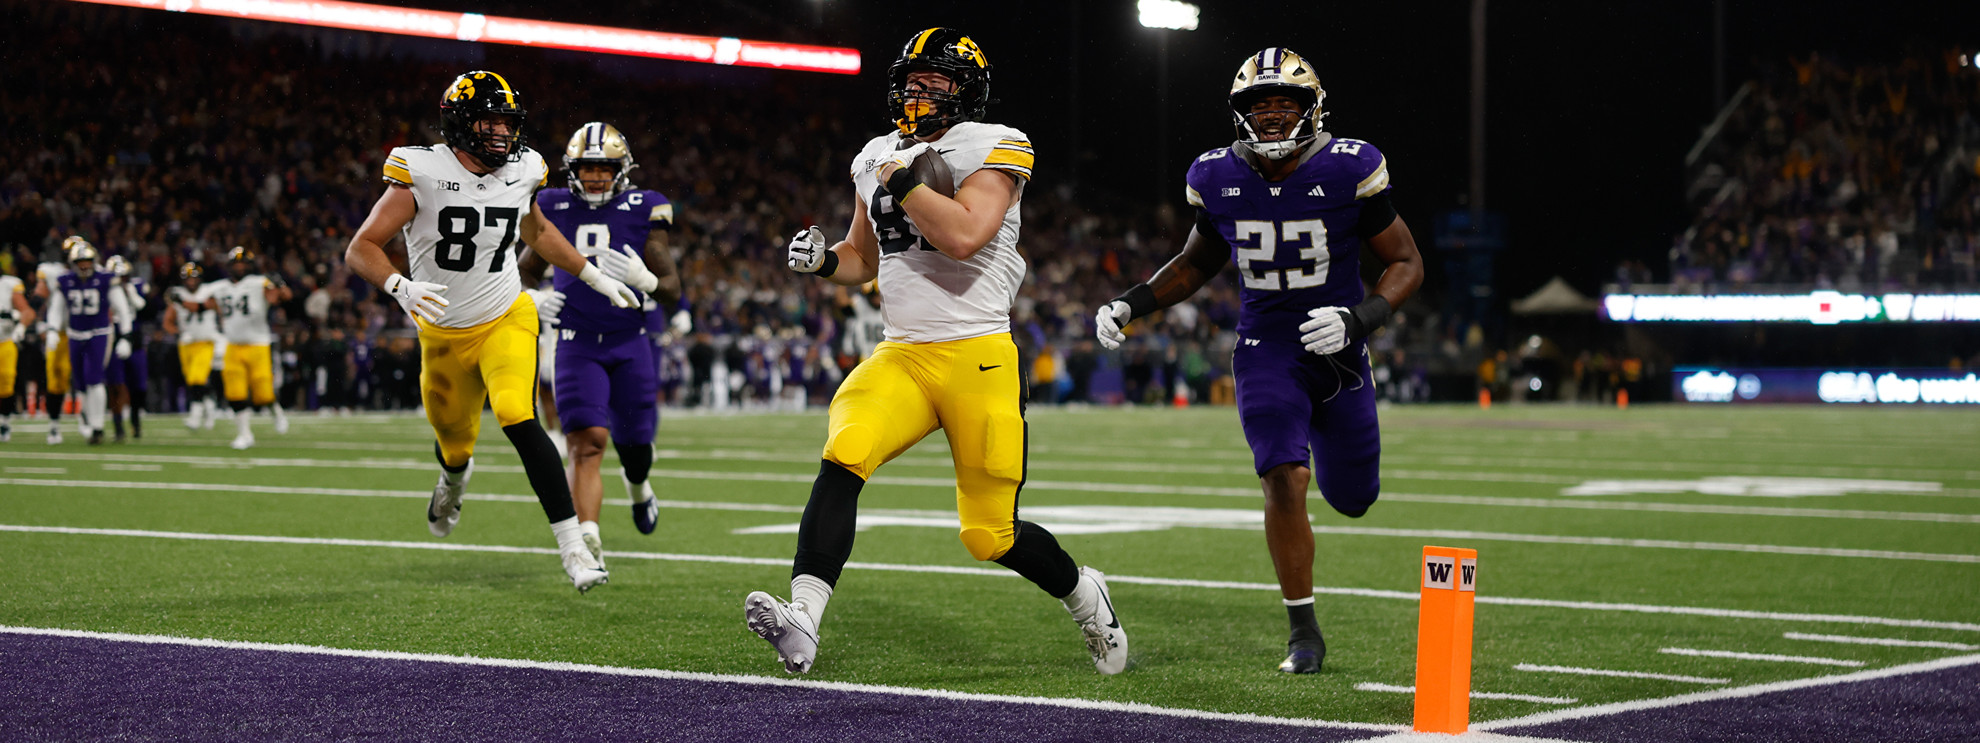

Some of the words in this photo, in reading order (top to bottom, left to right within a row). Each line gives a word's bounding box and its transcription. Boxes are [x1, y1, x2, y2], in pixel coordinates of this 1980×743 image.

[628, 193, 644, 204] C
[1269, 187, 1282, 196] W
[870, 185, 938, 256] 8
[434, 205, 519, 273] 87
[1235, 218, 1331, 291] 23
[67, 288, 100, 316] 33
[561, 329, 576, 340] W
[1427, 562, 1453, 583] W
[1461, 565, 1475, 585] W
